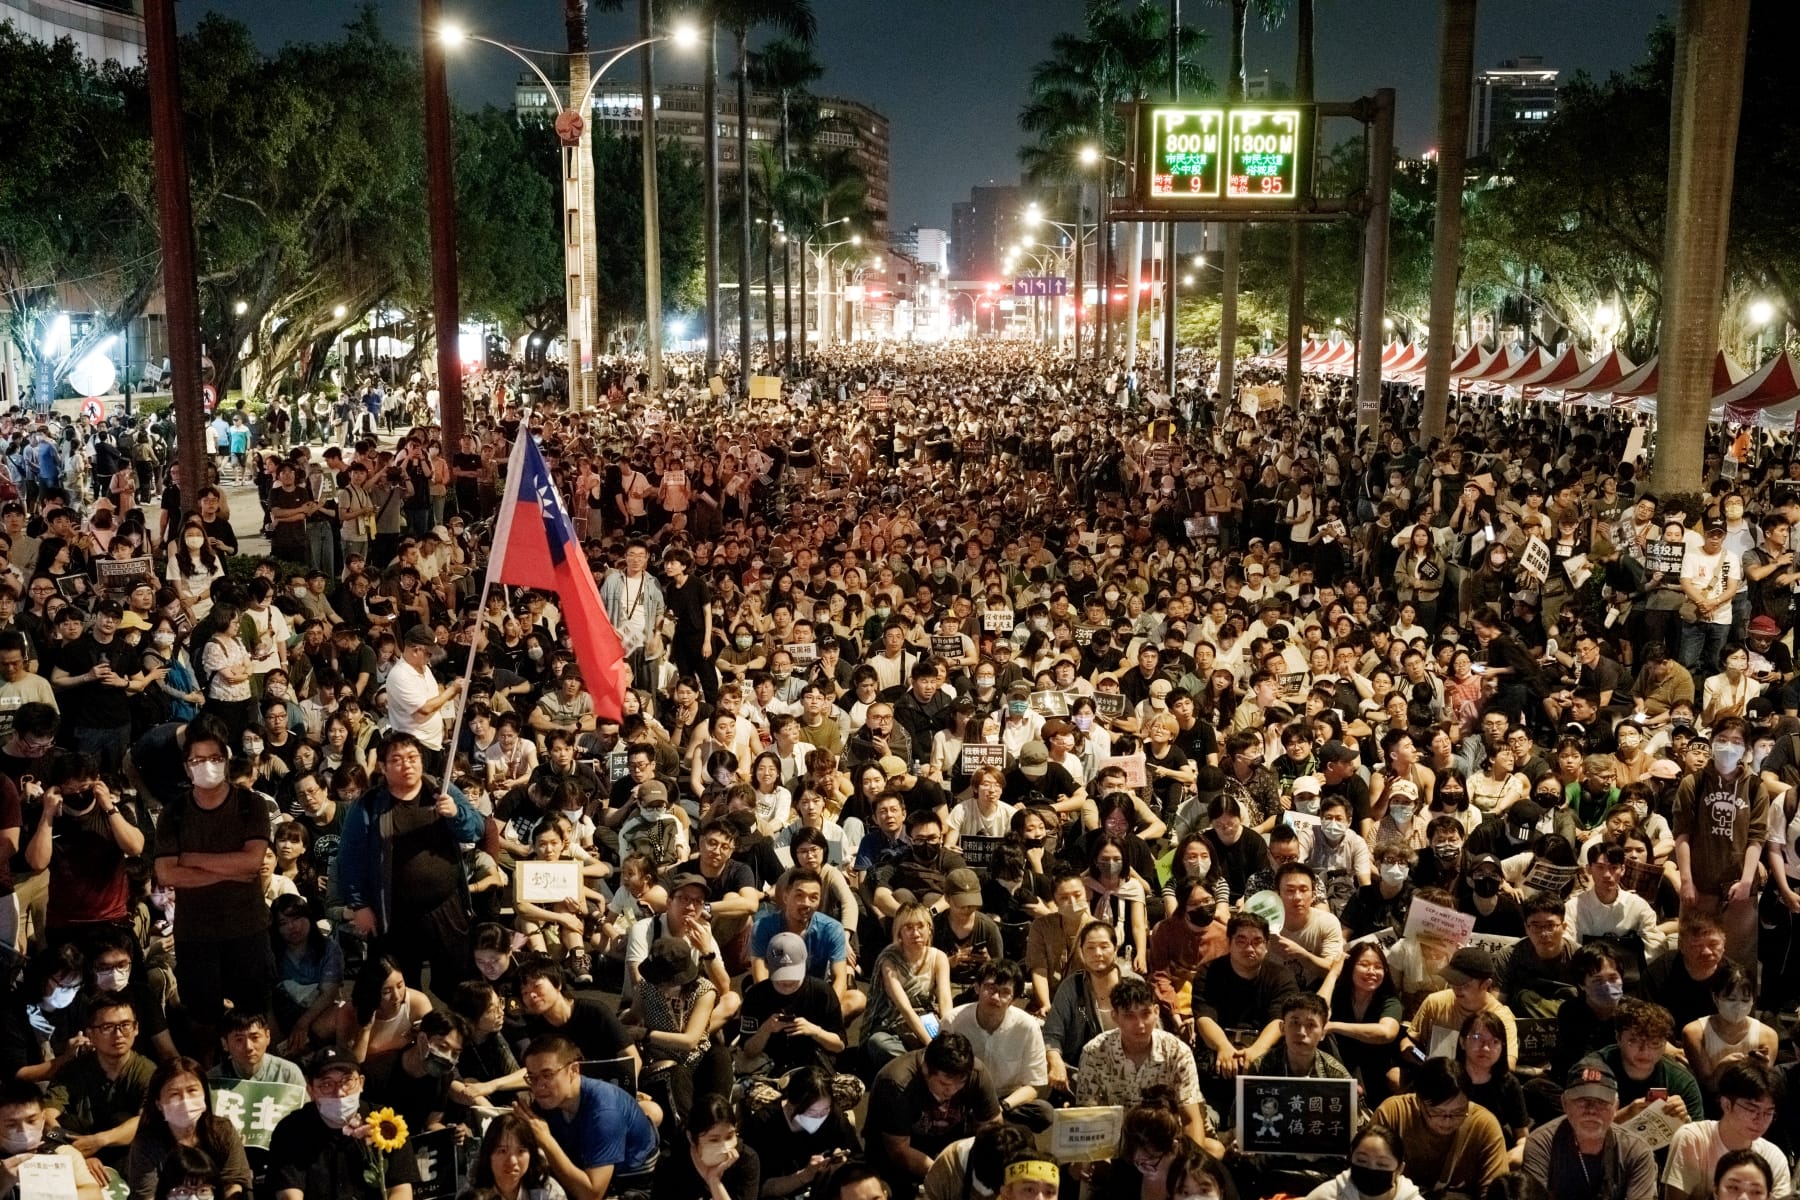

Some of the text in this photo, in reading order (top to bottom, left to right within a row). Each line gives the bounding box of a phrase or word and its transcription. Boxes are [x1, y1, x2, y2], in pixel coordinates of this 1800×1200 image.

[1166, 134, 1216, 153] 800 M
[1233, 134, 1292, 154] 1800 M
[1166, 154, 1206, 165] 市民大道
[1242, 154, 1283, 165] 市民大道
[1190, 176, 1201, 193] 9
[1261, 177, 1282, 194] 95
[1704, 791, 1748, 810] ECSTASY
[1712, 826, 1732, 836] XTC
[1288, 1094, 1343, 1113] 黃國昌
[1288, 1119, 1344, 1136] 偽君子
